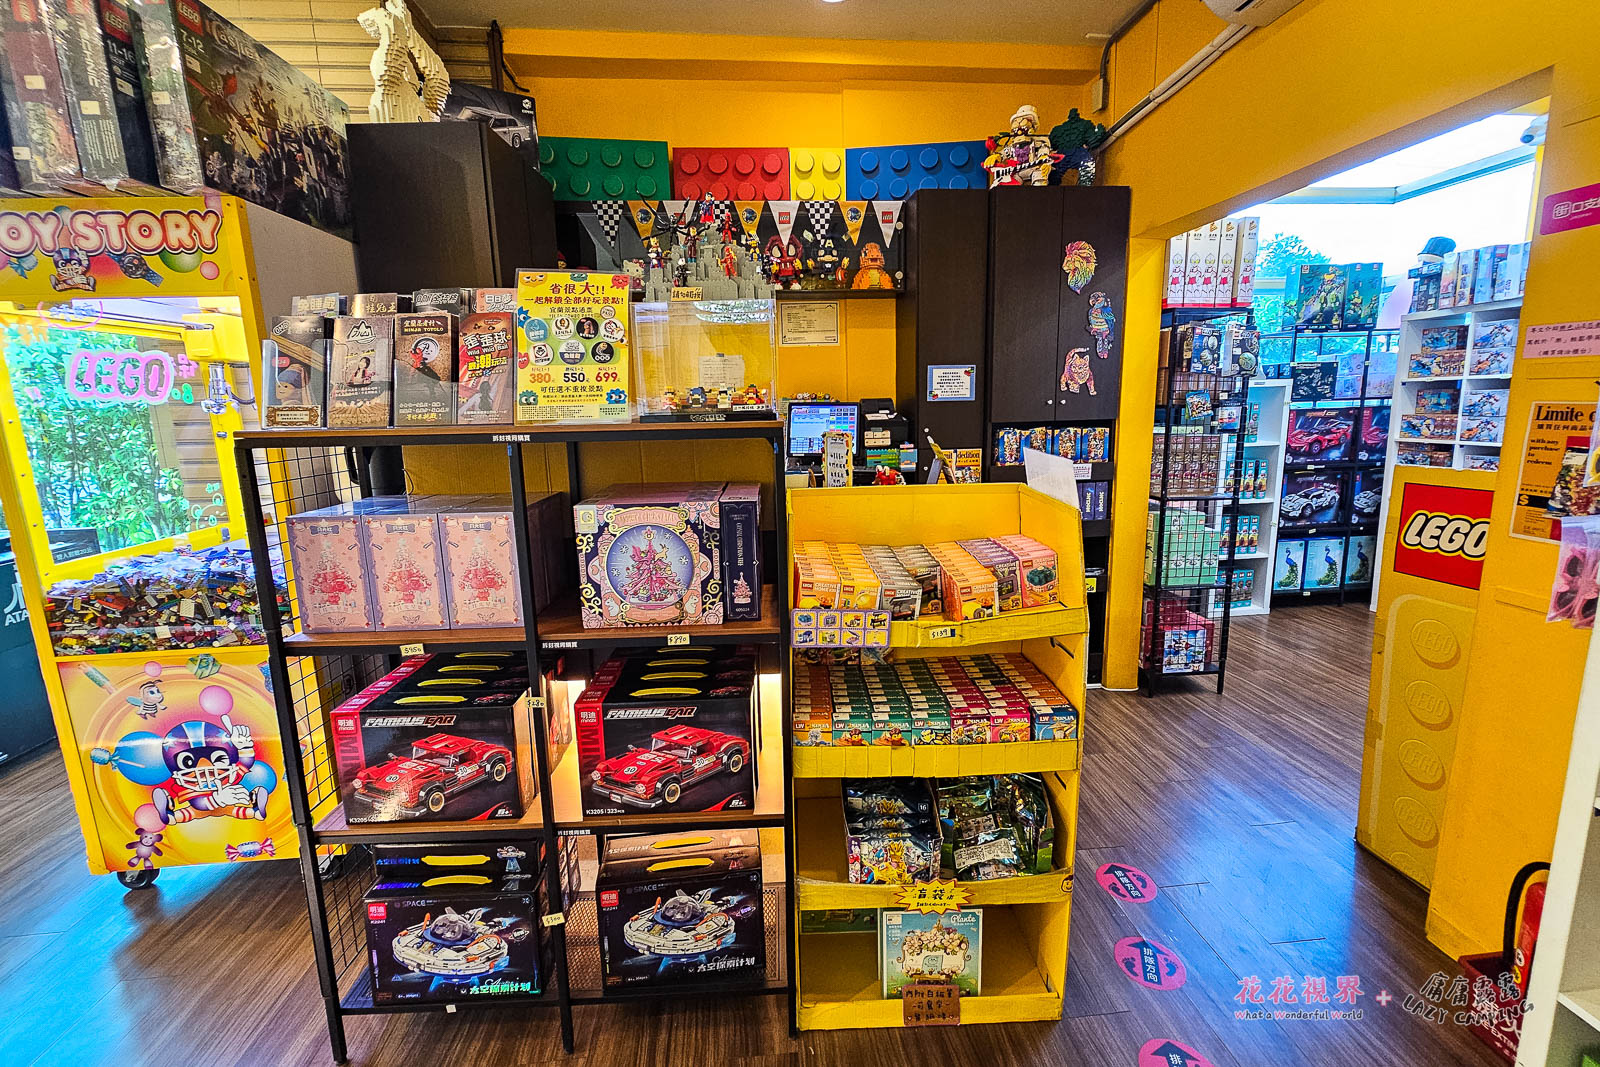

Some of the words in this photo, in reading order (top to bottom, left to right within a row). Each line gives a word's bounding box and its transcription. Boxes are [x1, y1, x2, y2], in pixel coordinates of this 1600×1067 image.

[178, 1, 201, 24] LEGO
[106, 39, 136, 63] 11-16
[180, 28, 204, 53] 7-12
[69, 209, 222, 256] STORY
[69, 350, 173, 403] LEGO
[529, 373, 551, 383] 380
[563, 372, 586, 382] 550
[595, 371, 618, 382] 699
[1536, 405, 1584, 422] Limite
[1402, 511, 1490, 560] LEGO
[1414, 627, 1456, 651] LEGO
[633, 884, 657, 892] SPACE
[1143, 947, 1158, 982] 排隊方向
